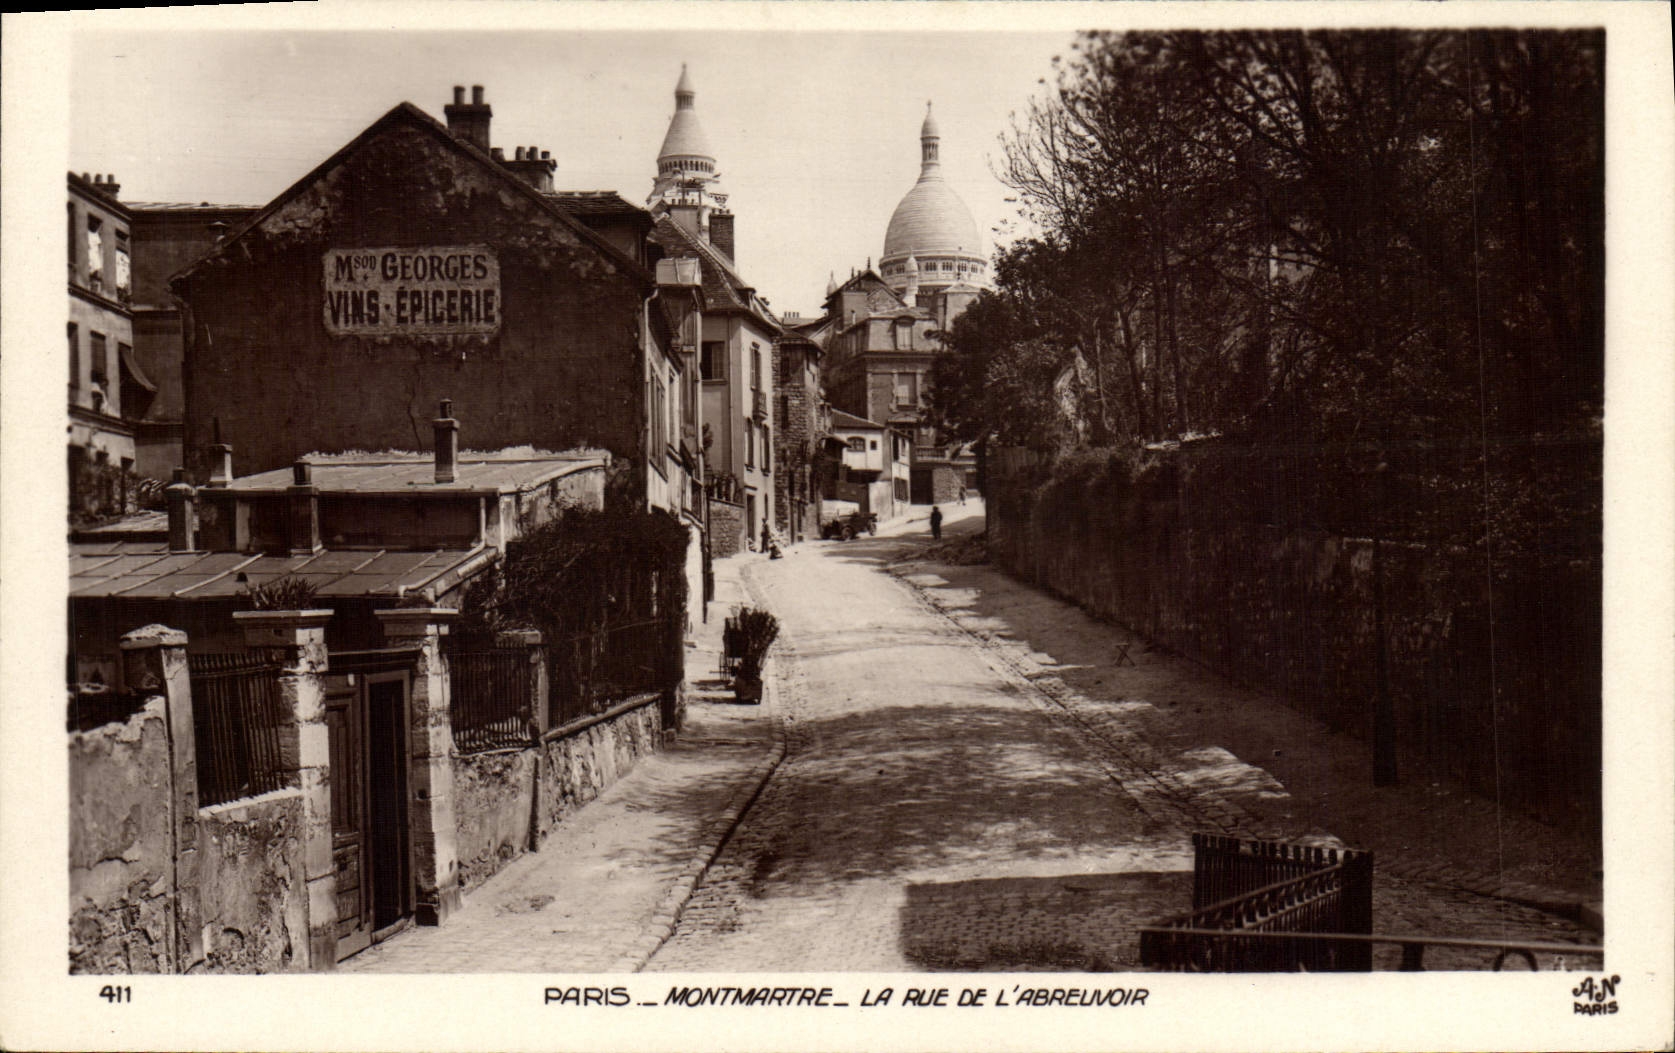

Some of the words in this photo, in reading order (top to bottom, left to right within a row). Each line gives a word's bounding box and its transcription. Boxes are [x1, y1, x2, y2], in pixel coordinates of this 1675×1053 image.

[380, 252, 488, 281] GEORGES
[328, 289, 380, 326] VINS
[395, 286, 496, 324] ÉPICERIE
